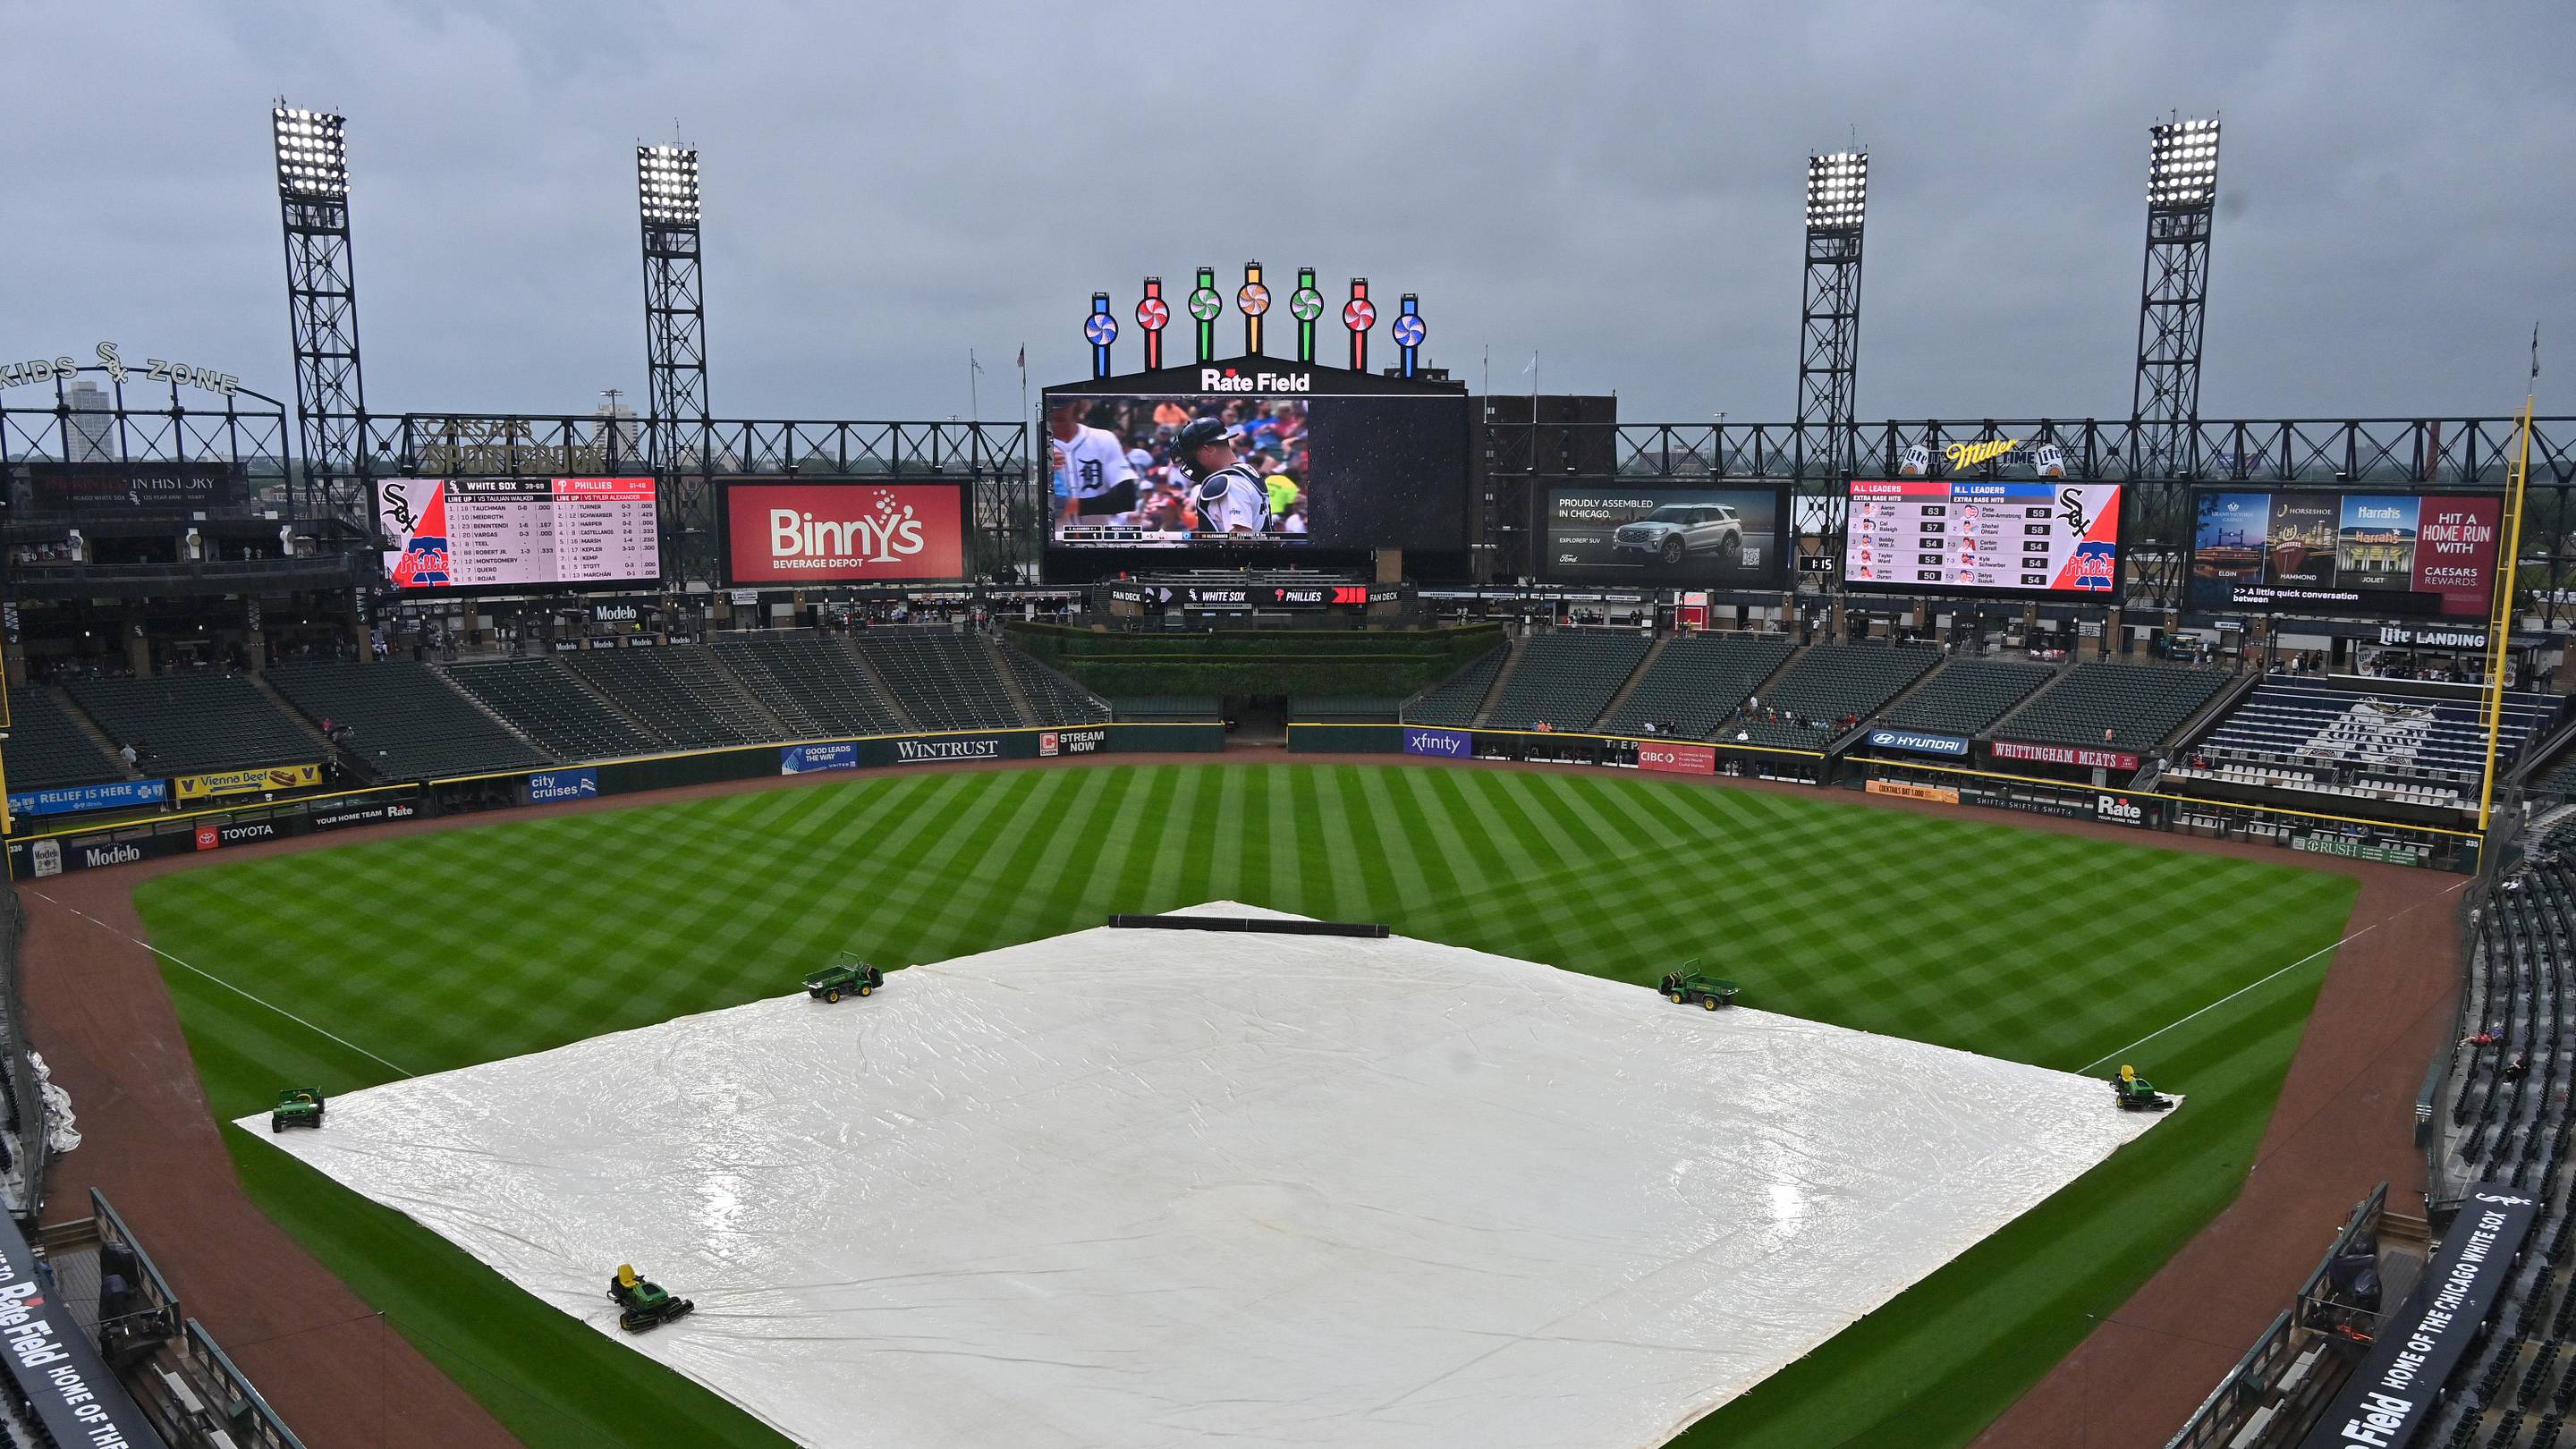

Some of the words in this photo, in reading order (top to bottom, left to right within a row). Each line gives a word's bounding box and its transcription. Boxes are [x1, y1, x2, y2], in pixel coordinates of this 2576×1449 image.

[0, 357, 79, 390] KIDS
[147, 359, 240, 397] ZONE
[1202, 369, 1253, 392] Rate
[1258, 369, 1309, 392] Field
[426, 419, 533, 438] CAESARS
[426, 445, 606, 474] SPORTSBOOK
[1946, 438, 2019, 471] Miller
[2003, 451, 2036, 463] TIME
[2038, 448, 2062, 465] Lite
[467, 482, 496, 490] WHITE
[499, 482, 516, 490] SOX
[575, 482, 612, 490] PHILLIES
[1559, 499, 1600, 508] PROUDLY
[1602, 499, 1653, 509] ASSEMBLED
[1559, 509, 1567, 517] IN
[1570, 510, 1611, 518] CHICAGO.
[2358, 506, 2401, 519] Harrah's
[2439, 513, 2462, 524] HIT
[2466, 513, 2477, 524] A
[2423, 525, 2458, 542] HOME
[2462, 526, 2490, 542] RUN
[2436, 543, 2474, 554] WITH
[773, 559, 826, 569] BEVERAGE
[829, 558, 863, 568] DEPOT
[1559, 555, 1577, 563] Ford
[1810, 559, 1832, 570] 1:15
[2425, 567, 2478, 576] CAESARS
[1113, 591, 1125, 600] FAN
[1125, 592, 1140, 601] DECK
[1202, 592, 1228, 601] WHITE
[1229, 592, 1245, 601] SOX
[1286, 592, 1321, 601] PHILLIES
[1370, 594, 1382, 603] FAN
[1383, 592, 1397, 601] DECK
[2233, 595, 2268, 604] between
[2257, 589, 2275, 597] little
[2277, 589, 2301, 599] quick
[2302, 591, 2359, 601] conversation
[597, 605, 637, 621] Modelo
[631, 639, 652, 647] Modelo
[670, 636, 691, 645] Modelo
[2379, 626, 2411, 646] Lite
[2417, 631, 2485, 647] LANDING
[556, 642, 577, 650] Modelo
[593, 640, 614, 649] Modelo
[1060, 731, 1104, 742] STREAM
[806, 747, 826, 755] GOOD
[828, 745, 851, 753] LEADS
[896, 741, 998, 758] WINTRUST
[1070, 741, 1095, 752] NOW
[1412, 734, 1460, 754] xfinity
[1897, 737, 1960, 750] HYUNDAI
[819, 753, 835, 761] WAY
[1640, 752, 1664, 762] CIBC
[1995, 743, 2073, 763] WHITTINGHAM
[2079, 750, 2116, 767] MEATS
[200, 773, 240, 786] Vienna
[243, 770, 268, 782] Beef
[531, 776, 555, 790] city
[40, 791, 81, 803] RELIEF
[86, 790, 97, 799] IS
[100, 785, 132, 797] HERE
[533, 784, 578, 799] cruises
[1879, 785, 1901, 794] COCKTAILS
[2098, 796, 2141, 818] Rate
[317, 817, 336, 826] YOUR
[338, 813, 360, 822] HOME
[361, 809, 382, 818] TEAM
[387, 806, 413, 818] Rate
[222, 826, 273, 840] TOYOTA
[10, 844, 22, 853] 330
[2320, 841, 2357, 857] RUSH
[2466, 840, 2479, 848] 335
[34, 849, 58, 860] Modelo
[87, 845, 140, 868] Modelo
[2479, 1210, 2506, 1232] SOX
[2460, 1231, 2496, 1263] WHITE
[2434, 1263, 2479, 1310] CHICAGO
[2420, 1308, 2452, 1334] THE
[2407, 1332, 2436, 1352] OF
[4, 1320, 70, 1368] Field
[47, 1364, 94, 1406] HOME
[74, 1404, 108, 1430] OF
[2381, 1348, 2425, 1390] HOME
[2341, 1392, 2413, 1448] Field
